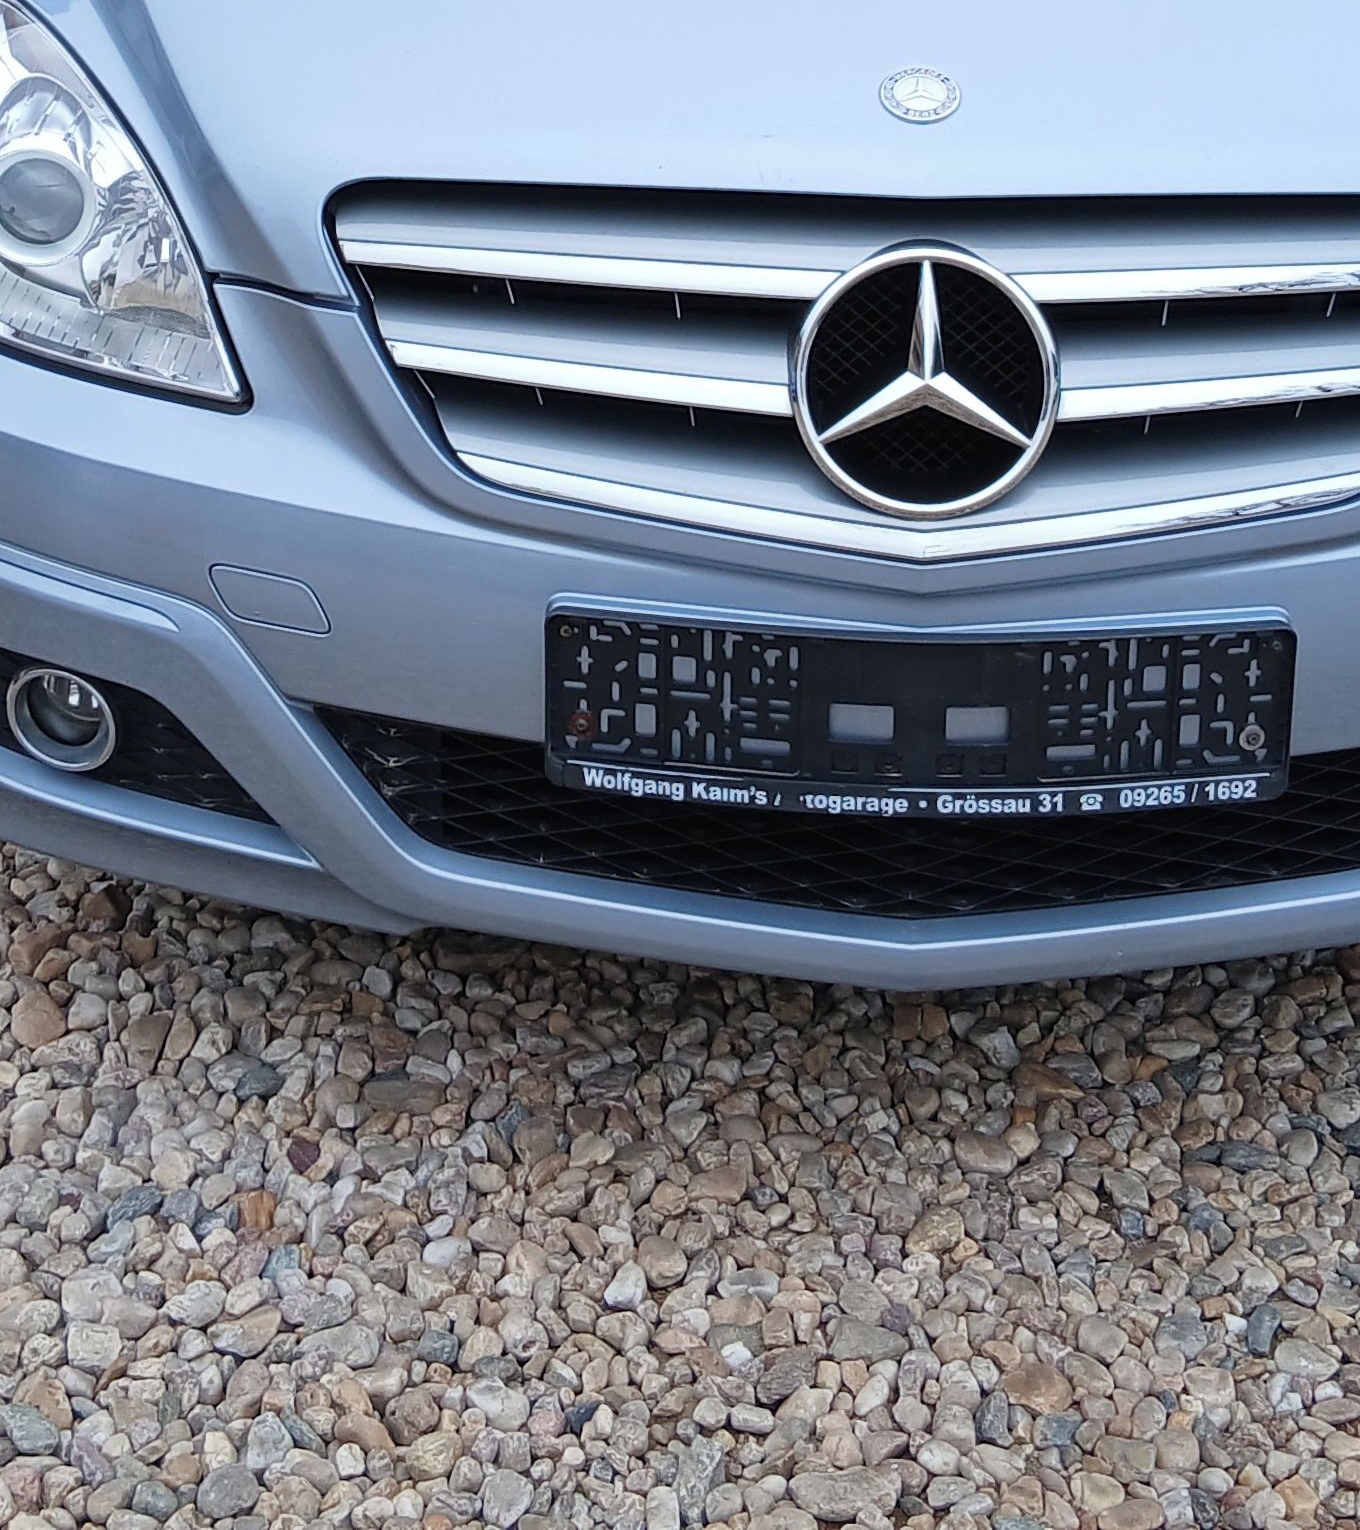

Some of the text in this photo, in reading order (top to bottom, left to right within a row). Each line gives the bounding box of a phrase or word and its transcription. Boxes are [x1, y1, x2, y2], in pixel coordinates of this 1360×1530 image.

[582, 767, 685, 801] Wolfgang
[773, 790, 909, 816] togarage
[936, 794, 1031, 815] Grössau
[1038, 794, 1064, 812] 31
[1119, 784, 1186, 808] 09265
[1204, 779, 1257, 802] 1692
